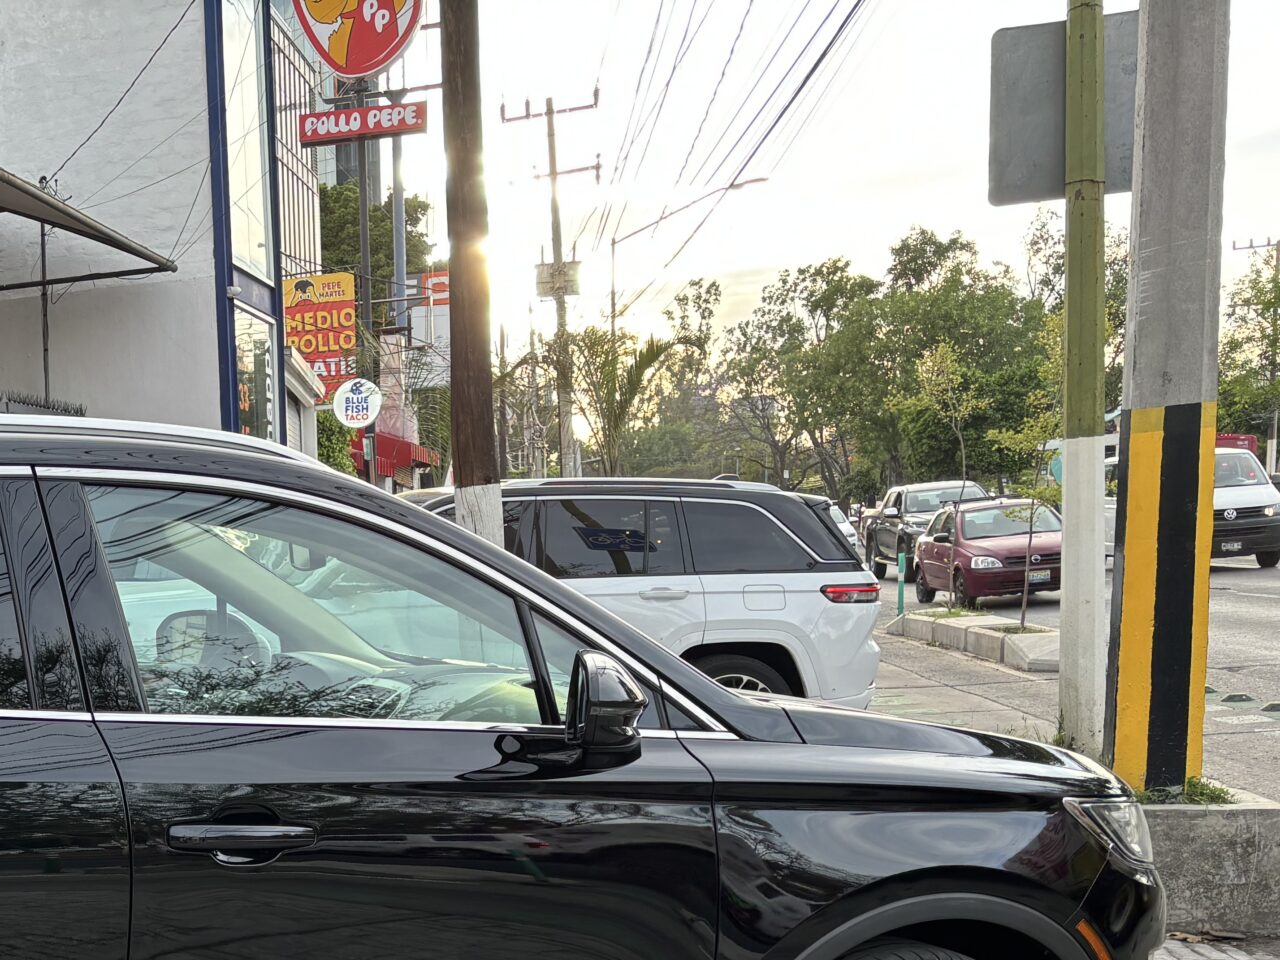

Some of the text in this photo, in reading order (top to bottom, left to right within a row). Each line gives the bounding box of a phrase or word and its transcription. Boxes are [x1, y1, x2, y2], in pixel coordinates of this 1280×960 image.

[305, 106, 418, 136] POLLO PEPE
[322, 281, 341, 291] PEPE
[319, 290, 346, 299] MARTES
[287, 308, 355, 333] MEDIO
[288, 330, 356, 353] POLLO
[345, 397, 368, 405] BLUE
[345, 404, 368, 413] FISH
[345, 413, 368, 421] TACO
